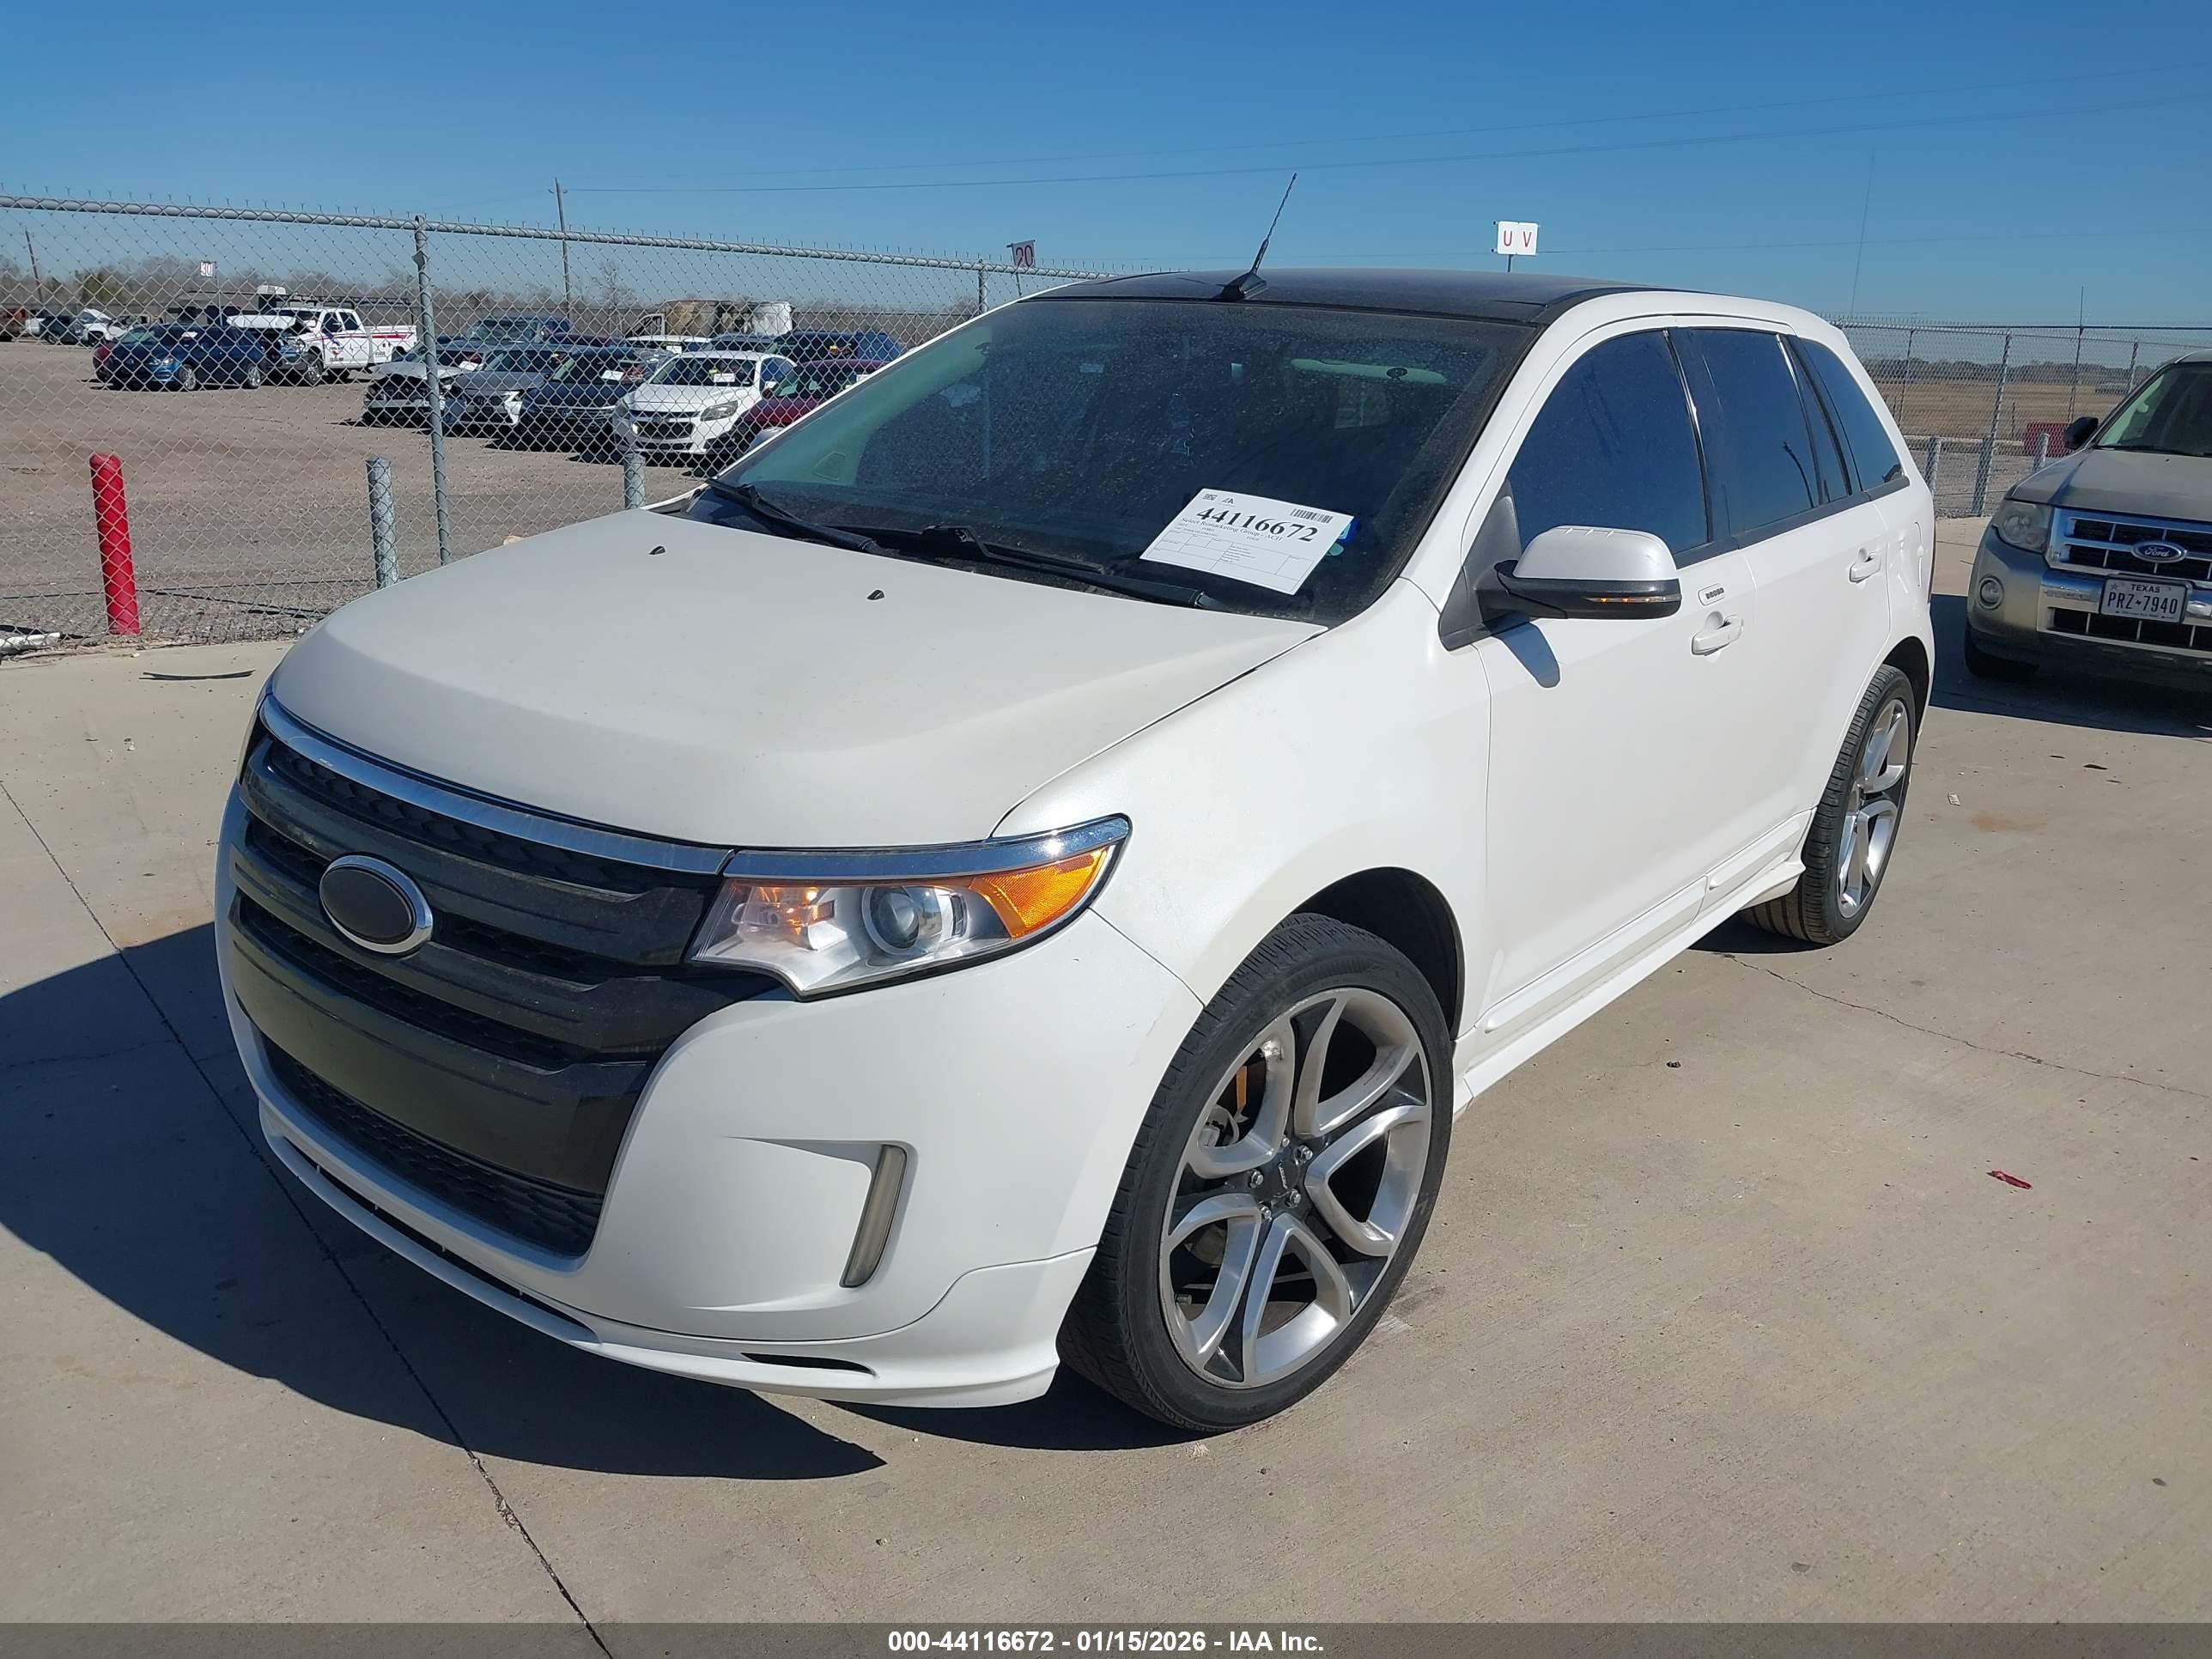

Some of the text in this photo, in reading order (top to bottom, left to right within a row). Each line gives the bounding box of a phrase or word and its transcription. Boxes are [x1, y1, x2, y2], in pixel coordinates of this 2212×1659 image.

[1504, 230, 1532, 247] U V
[1015, 245, 1034, 267] 20
[1196, 507, 1318, 542] 44116672
[1200, 520, 1238, 532] Remarketing
[2144, 546, 2170, 557] Ford
[2130, 584, 2160, 593] TEXAS
